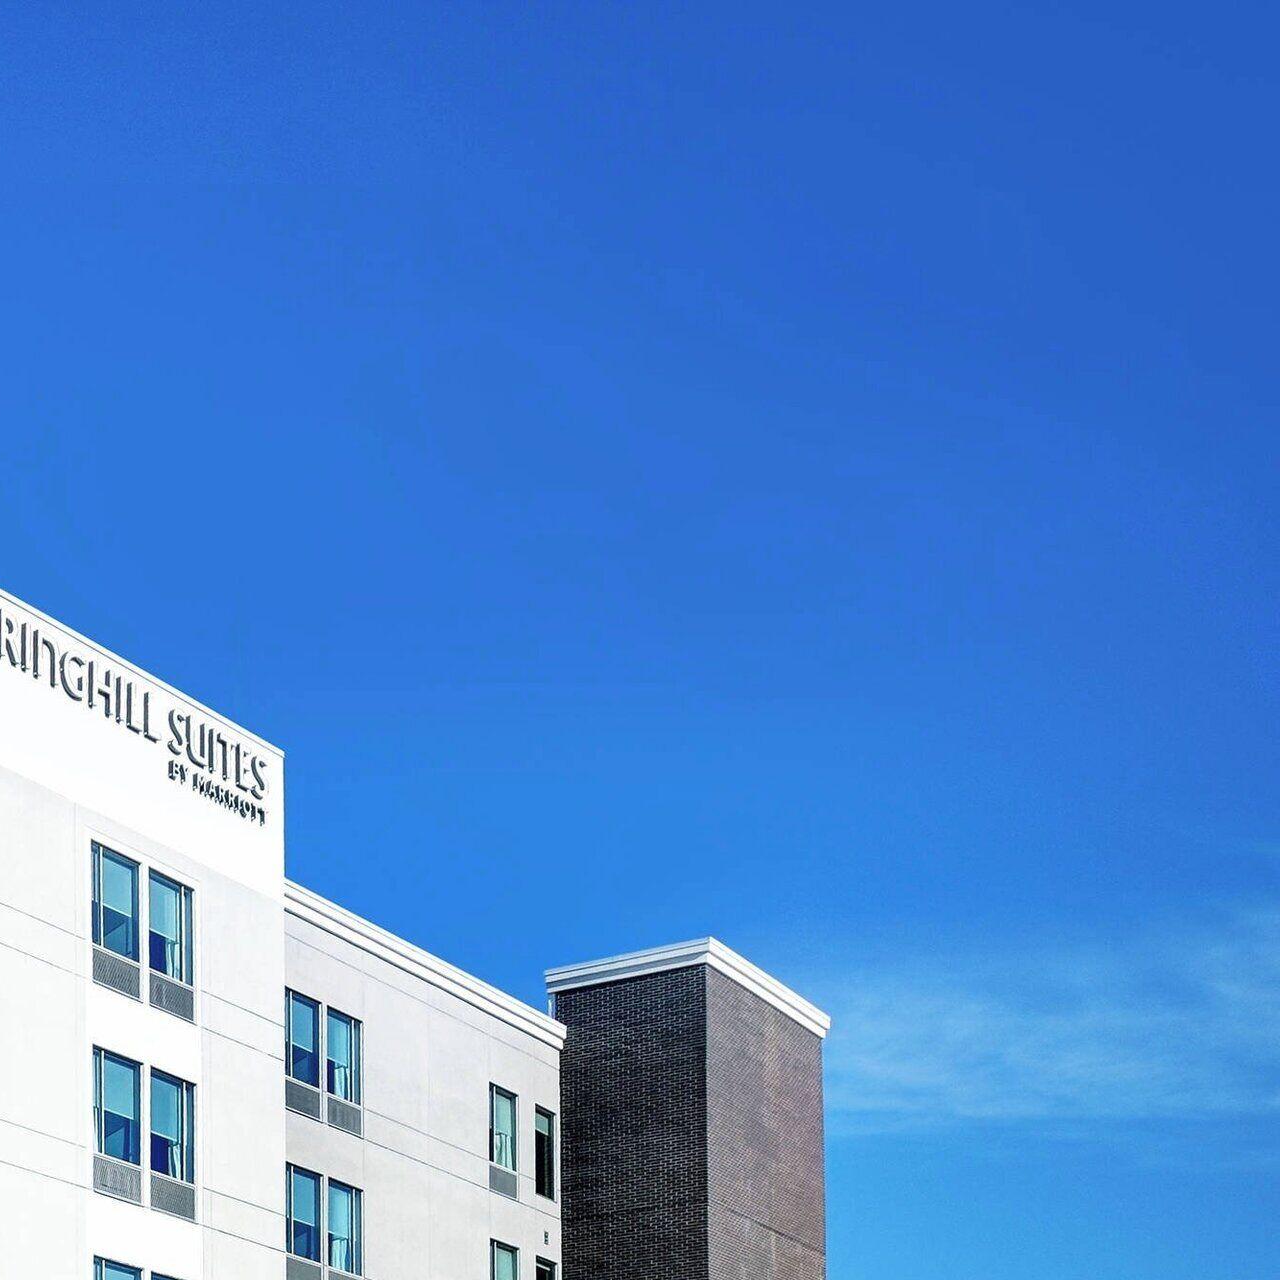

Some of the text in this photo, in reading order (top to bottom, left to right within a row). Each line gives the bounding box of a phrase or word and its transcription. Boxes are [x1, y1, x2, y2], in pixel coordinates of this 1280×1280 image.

[167, 707, 269, 800] SUITES
[168, 760, 267, 827] BY MARRIOTT
